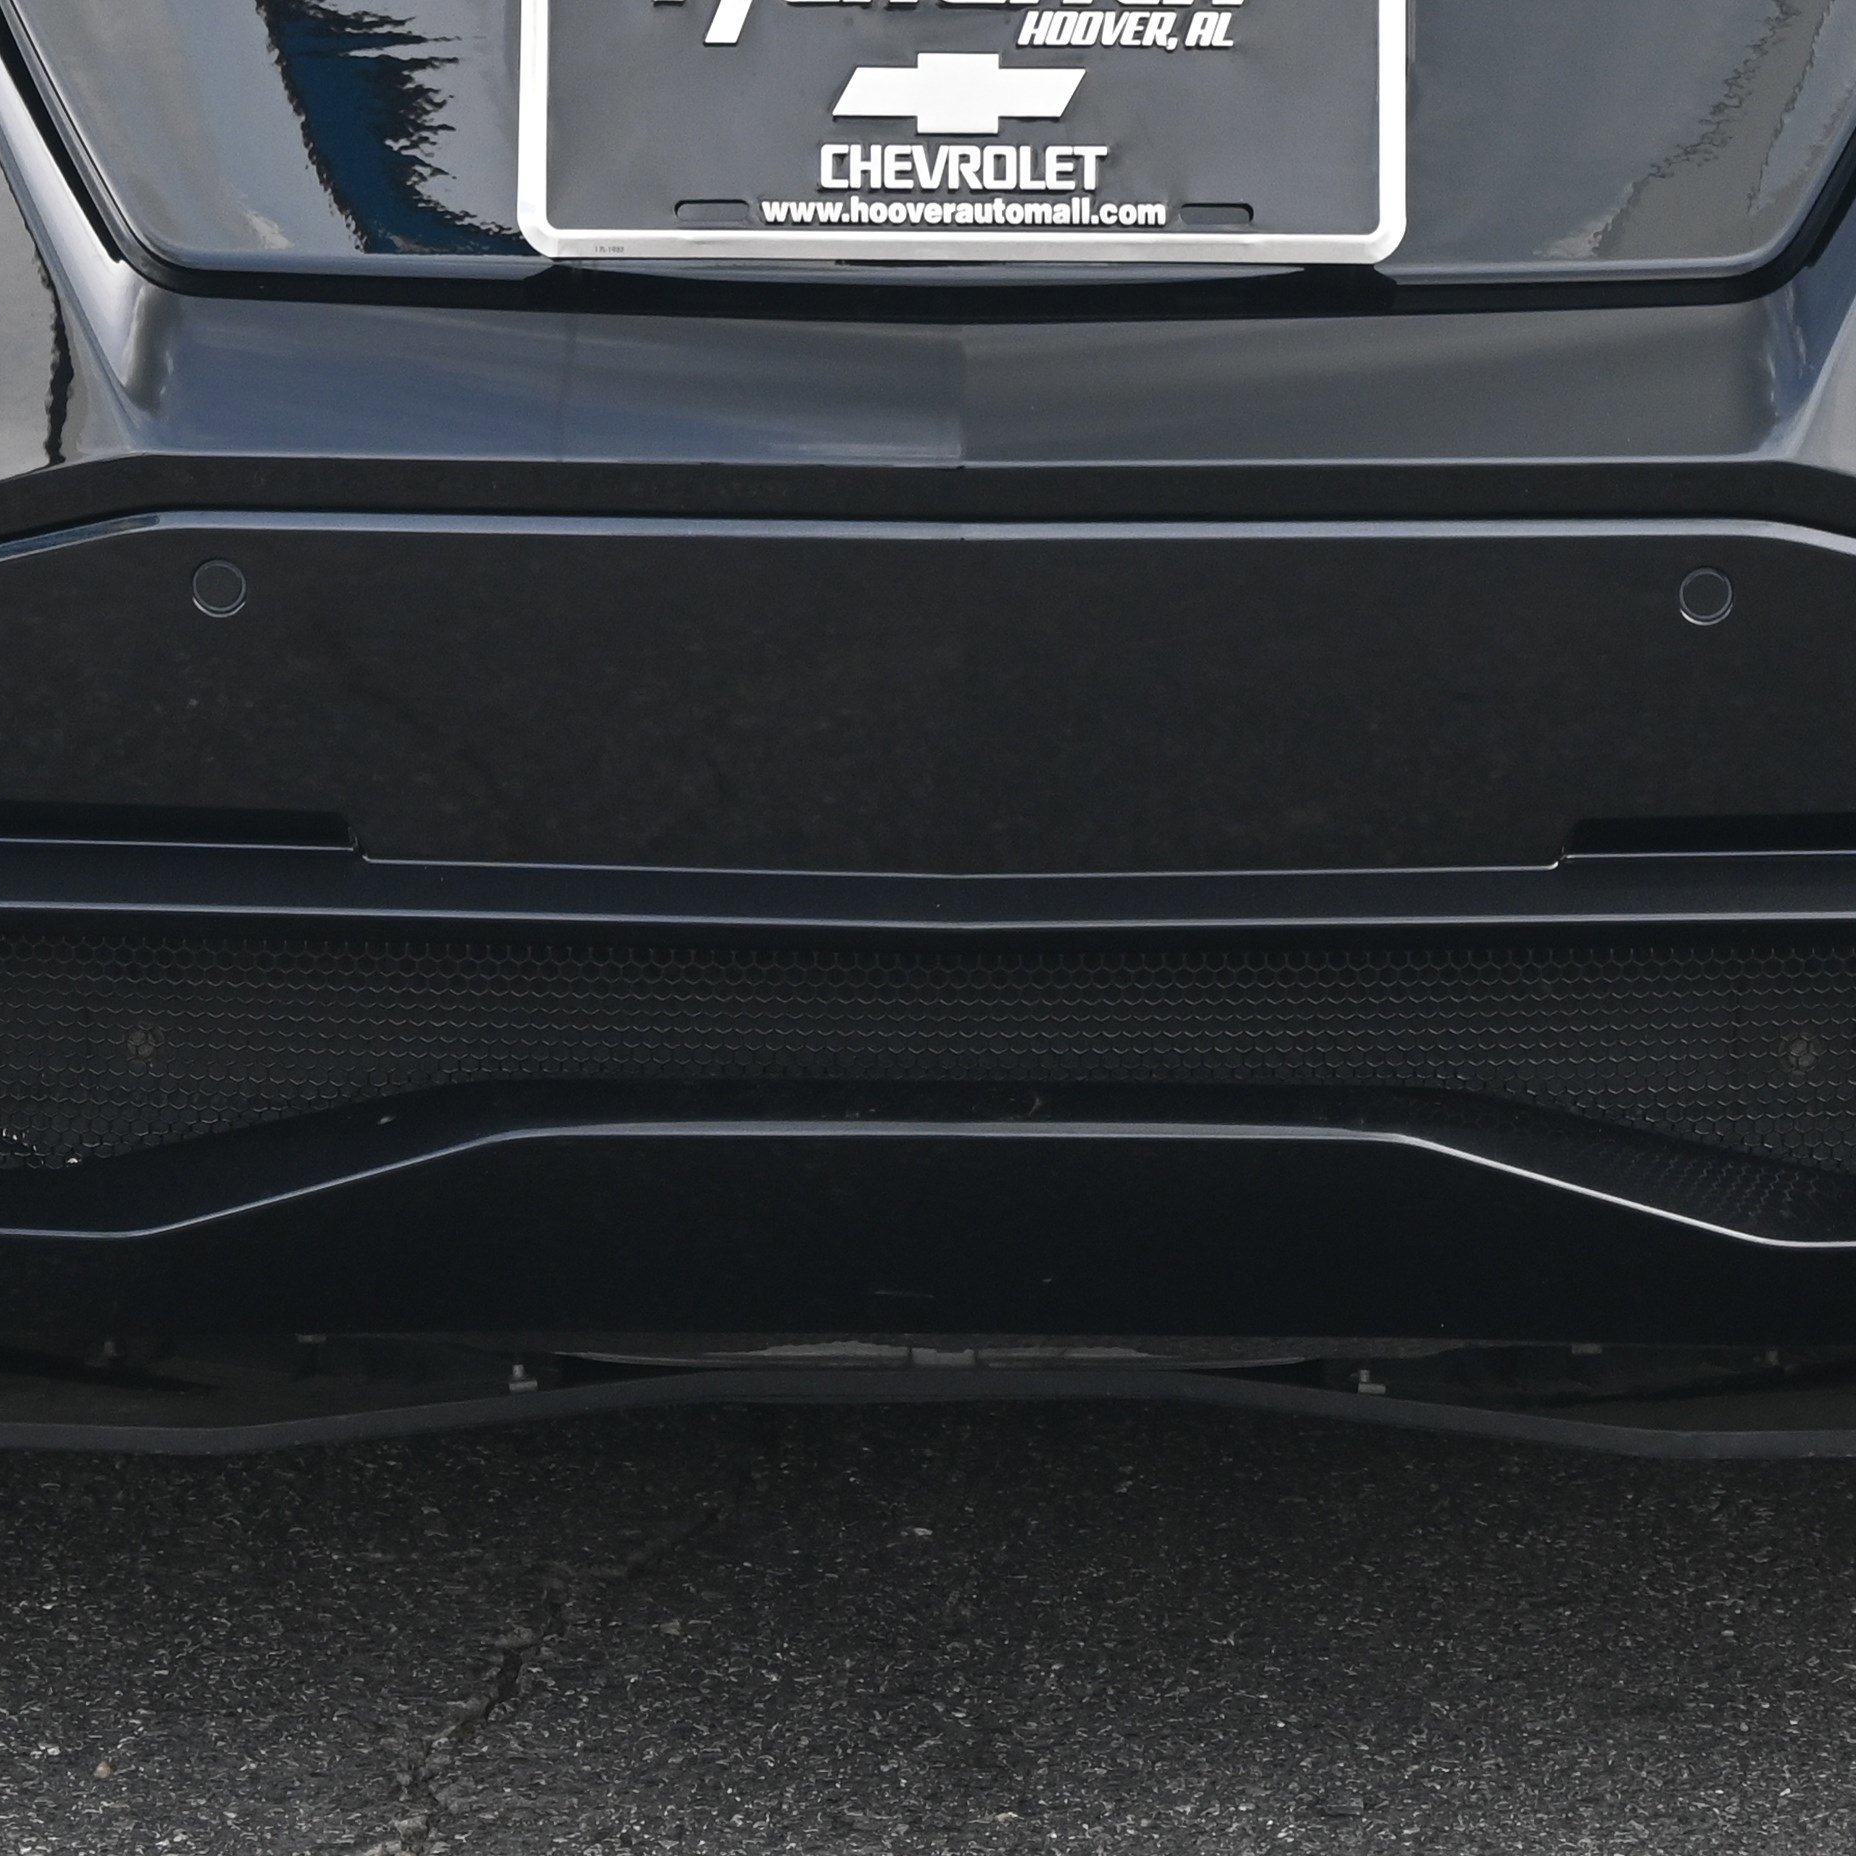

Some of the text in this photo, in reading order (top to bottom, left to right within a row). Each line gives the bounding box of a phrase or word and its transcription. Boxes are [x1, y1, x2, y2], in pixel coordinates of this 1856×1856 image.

[1016, 10, 1236, 51] HOOVER, AL
[819, 143, 1109, 191] CHEVROLET
[760, 195, 1168, 227] www.hooverautomall.com
